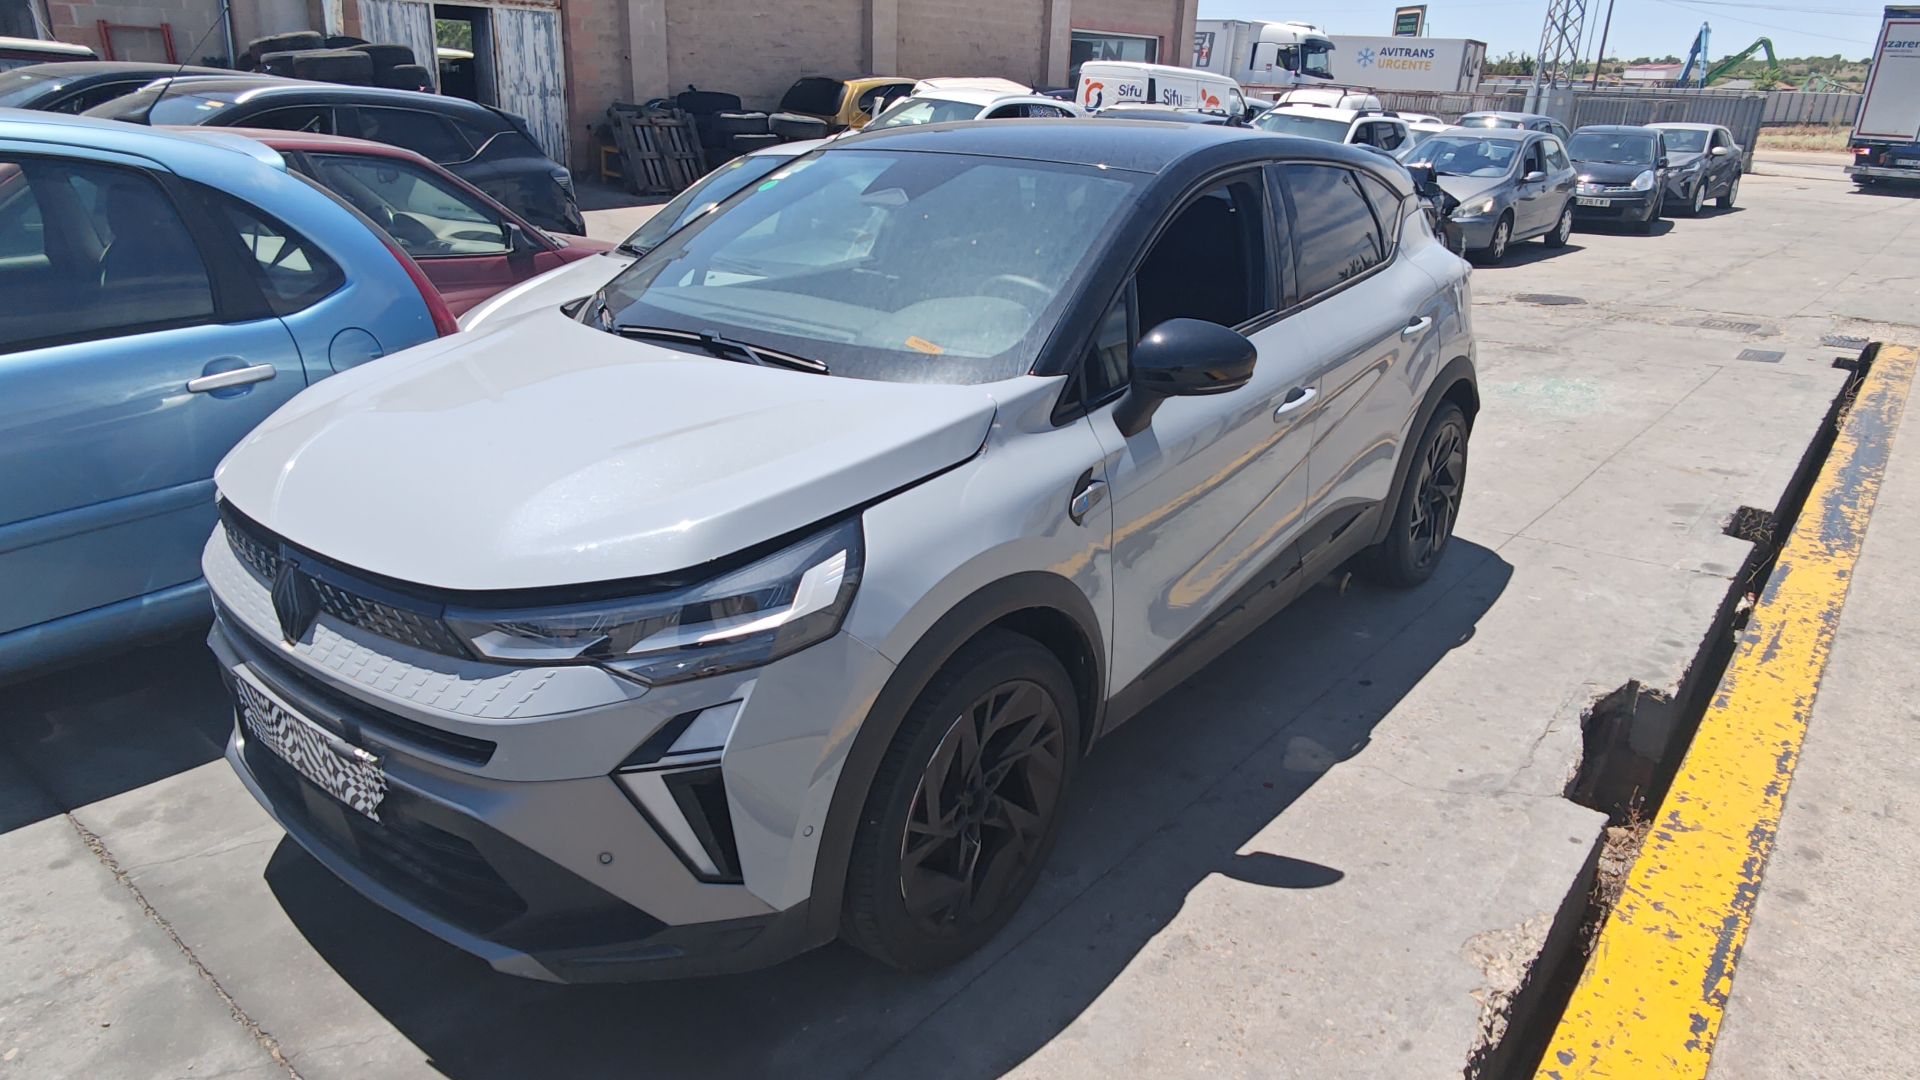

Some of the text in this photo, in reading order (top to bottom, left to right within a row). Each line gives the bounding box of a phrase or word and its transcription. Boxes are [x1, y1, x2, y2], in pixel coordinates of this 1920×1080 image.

[1379, 47, 1435, 58] AVITRANS
[1377, 59, 1432, 71] URGENTE
[1118, 84, 1142, 97] Sifu
[1163, 88, 1182, 106] Sifu
